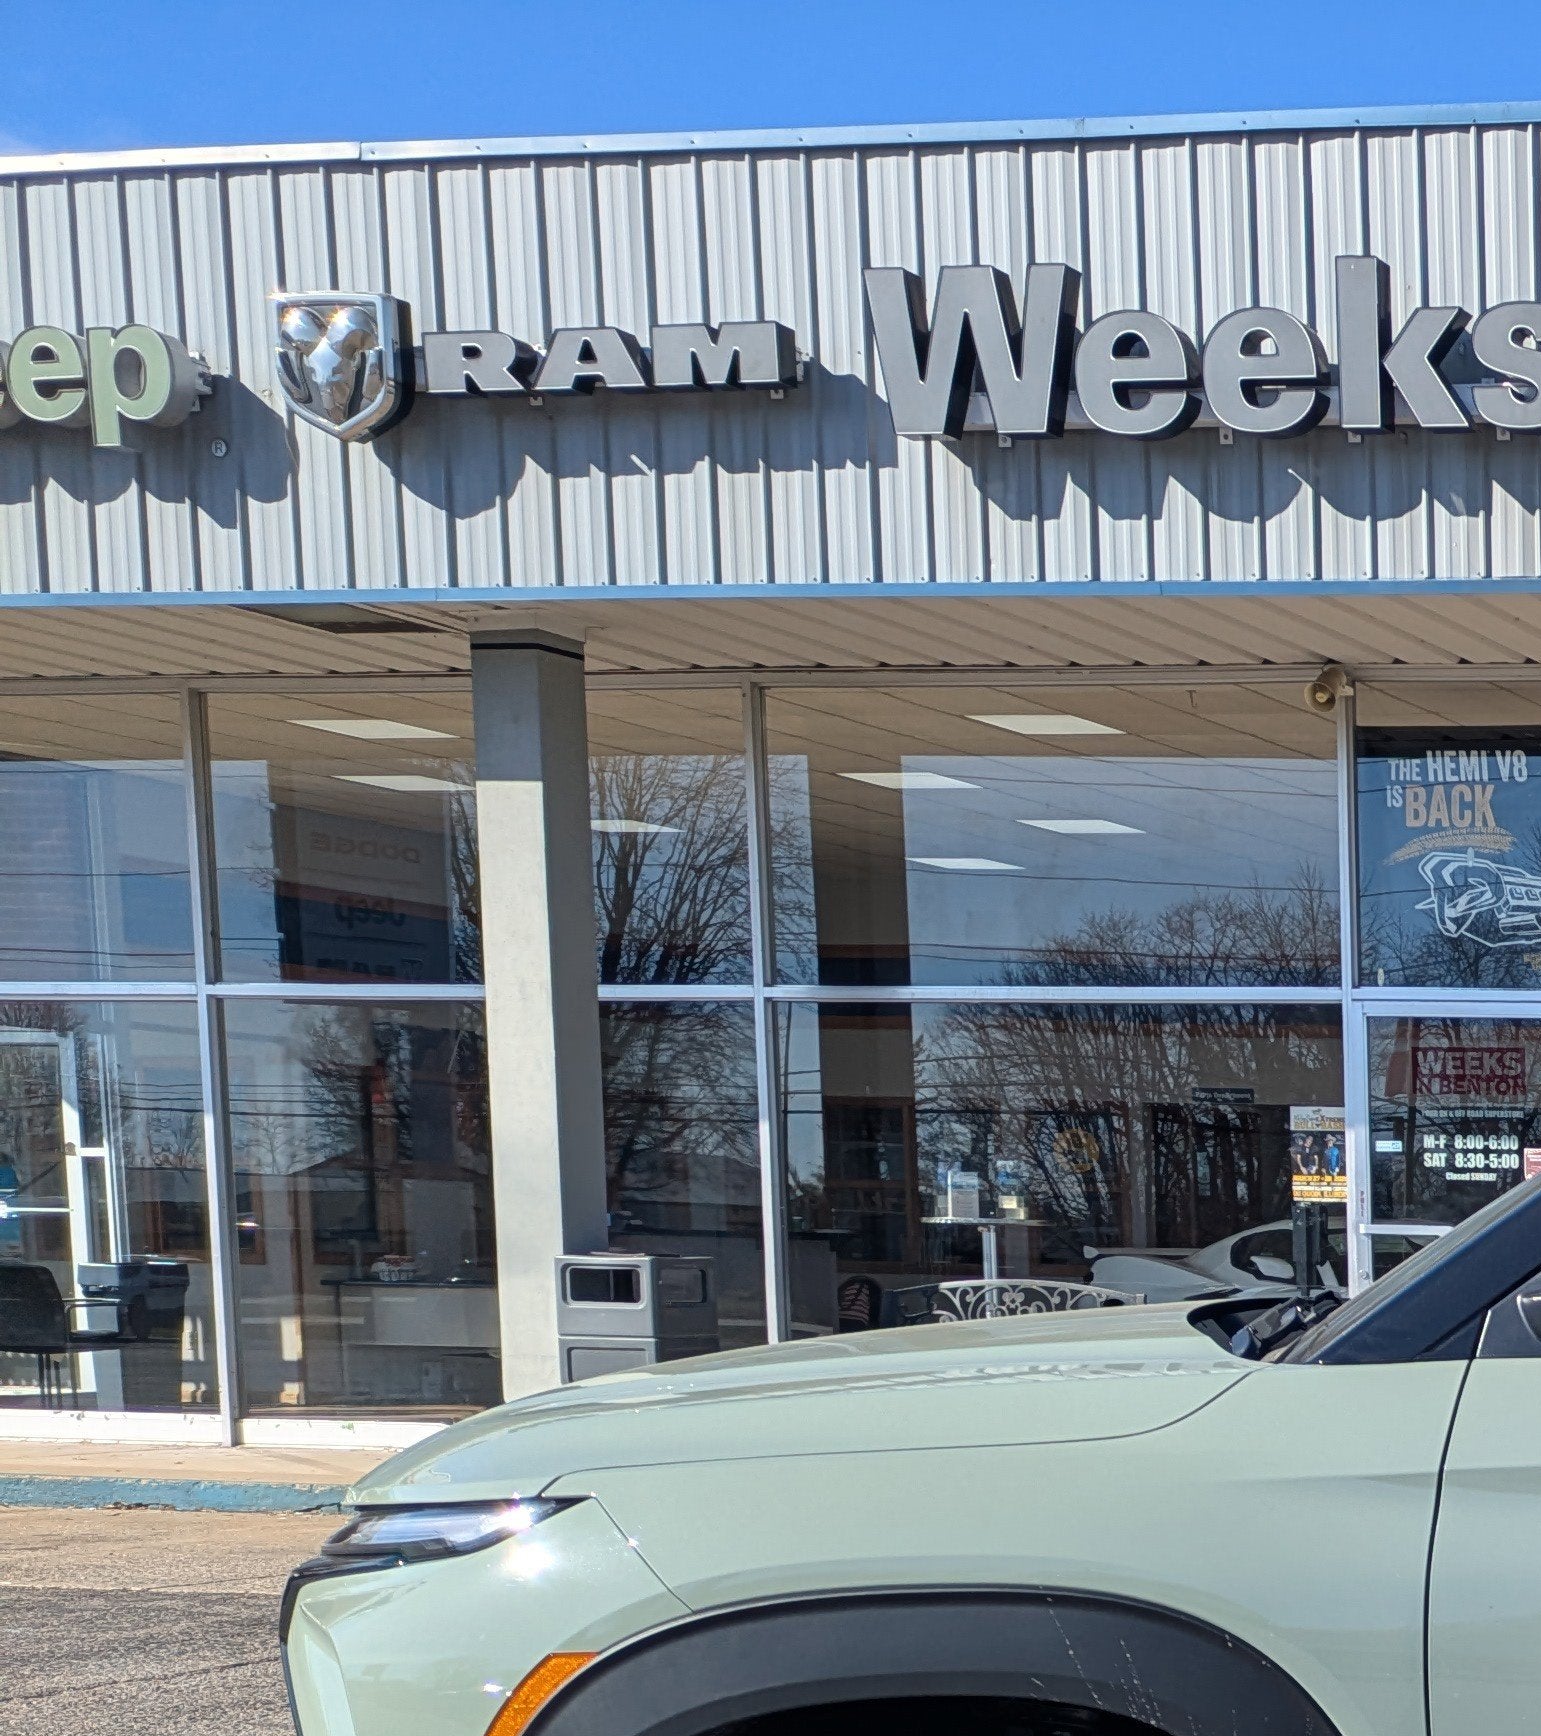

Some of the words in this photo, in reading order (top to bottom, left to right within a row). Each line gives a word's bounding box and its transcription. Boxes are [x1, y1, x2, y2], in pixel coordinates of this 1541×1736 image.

[423, 320, 797, 396] RAM
[0, 323, 178, 448] ep
[1387, 758, 1422, 782] THE
[1426, 750, 1489, 782] HEMI
[1495, 750, 1528, 782] V8
[1405, 784, 1497, 828] BACK
[1416, 1051, 1522, 1076] WEEKS
[1423, 1134, 1447, 1149] M-F
[1454, 1134, 1519, 1150] 8:00-6:00
[1423, 1153, 1448, 1168] SAT
[1454, 1152, 1520, 1169] 8:30-5:00
[1445, 1171, 1471, 1181] Closed
